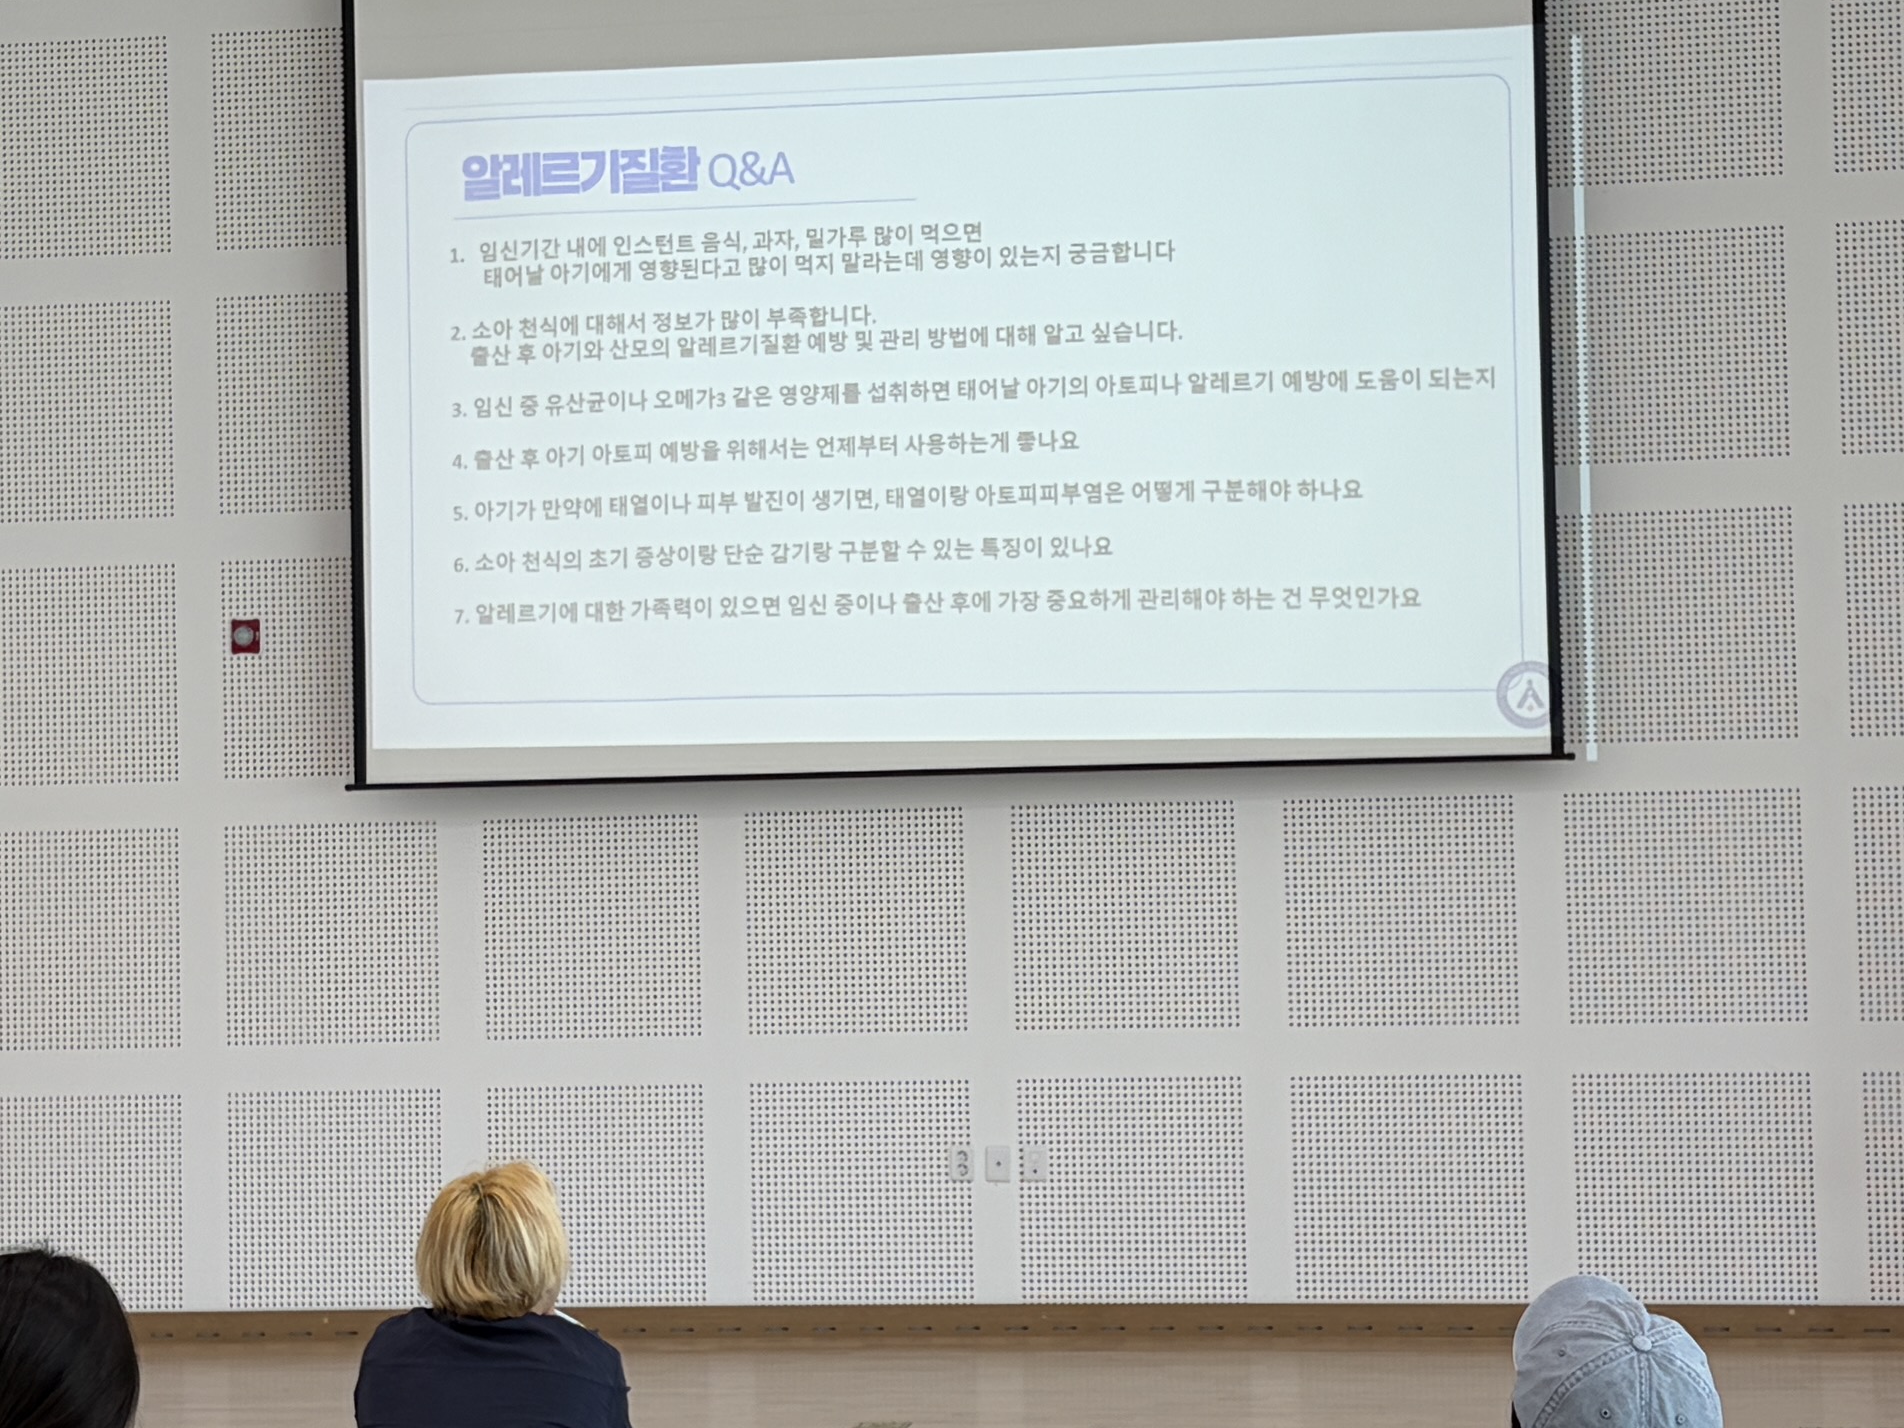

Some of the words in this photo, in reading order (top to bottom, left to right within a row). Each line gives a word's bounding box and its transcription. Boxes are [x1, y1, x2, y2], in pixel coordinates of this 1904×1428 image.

[462, 146, 701, 201] 알레르기질환
[709, 151, 795, 191] Q&A
[479, 237, 561, 263] 임신기간
[567, 234, 607, 258] 내에
[613, 233, 696, 257] 인스턴트
[806, 226, 867, 249] 밀가루
[874, 224, 912, 246] 많이
[921, 221, 981, 245] 먹으면
[484, 264, 544, 288] 태어날
[551, 260, 631, 285] 아기에게
[749, 255, 787, 277] 많이
[795, 253, 833, 276] 먹지
[842, 249, 923, 274] 말라는데
[931, 246, 991, 269] 영향이
[999, 244, 1060, 268] 있는지
[1068, 239, 1175, 265] 궁금합니다
[471, 344, 511, 366] 출산
[517, 343, 536, 365] 후
[543, 339, 604, 363] 아기와
[609, 337, 669, 360] 산모의
[677, 333, 801, 358] 알레르기질환
[807, 331, 848, 353] 예방
[855, 330, 873, 352] 및
[879, 328, 919, 351] 관리
[928, 326, 988, 349] 방법에
[996, 324, 1036, 347] 대해
[1044, 323, 1085, 345] 알고
[1091, 320, 1182, 344] 싶습니다.
[472, 318, 513, 340] 소아
[519, 314, 578, 339] 천식에
[586, 312, 645, 335] 대해서
[653, 310, 715, 333] 정보가
[721, 308, 759, 330] 많이
[767, 304, 876, 330] 부족합니다.
[474, 396, 512, 418] 임신
[520, 395, 539, 417] 중
[545, 389, 648, 416] 유산균이나
[654, 387, 726, 410] 오메가3
[733, 386, 772, 408] 같은
[779, 383, 861, 406] 영양제를
[868, 380, 950, 403] 섭취하면
[957, 377, 1020, 401] 태어날
[1026, 375, 1088, 399] 아기의
[1096, 373, 1182, 397] 아토피나
[1188, 370, 1273, 394] 알레르기
[1282, 370, 1348, 392] 예방에
[1355, 368, 1421, 391] 도움이
[1428, 366, 1495, 390] 되는지
[474, 448, 515, 470] 출산
[521, 448, 539, 469] 후
[546, 445, 584, 468] 아기
[592, 442, 651, 465] 아토피
[660, 440, 721, 463] 예방을
[727, 437, 809, 461] 위해서는
[816, 435, 897, 458] 언제부터
[905, 431, 1009, 456] 사용하는게
[1017, 430, 1080, 452] 좋나요
[475, 500, 536, 522] 아기가
[543, 497, 602, 520] 만약에
[610, 493, 691, 517] 태열이나
[697, 492, 738, 514] 피부
[744, 490, 804, 512] 발진이
[886, 485, 969, 508] 태열이랑
[976, 482, 1125, 507] 아토피피부염은
[1202, 479, 1291, 502] 구분해야
[1297, 478, 1363, 501] 하나요
[475, 551, 515, 573] 소아
[522, 550, 581, 572] 천식의
[589, 547, 627, 569] 초기
[635, 544, 717, 568] 증상이랑
[724, 544, 763, 565] 단순
[771, 541, 832, 564] 감기랑
[838, 540, 901, 563] 구분할
[907, 540, 926, 561] 수
[934, 538, 974, 560] 있는
[981, 536, 1042, 560] 특징이
[1051, 535, 1113, 558] 있나요
[476, 602, 577, 624] 알레르기에
[585, 600, 625, 622] 대한
[632, 597, 711, 620] 가족력이
[720, 596, 780, 618] 있으면
[788, 594, 826, 616] 임신
[835, 593, 897, 616] 중이나
[903, 592, 944, 614] 출산
[950, 591, 991, 613] 후에
[999, 591, 1040, 612] 가장
[1047, 588, 1130, 612] 중요하게
[1138, 588, 1226, 610] 관리해야
[1232, 588, 1275, 610] 하는
[1283, 587, 1301, 609] 건
[1309, 586, 1421, 609] 무엇인가요
